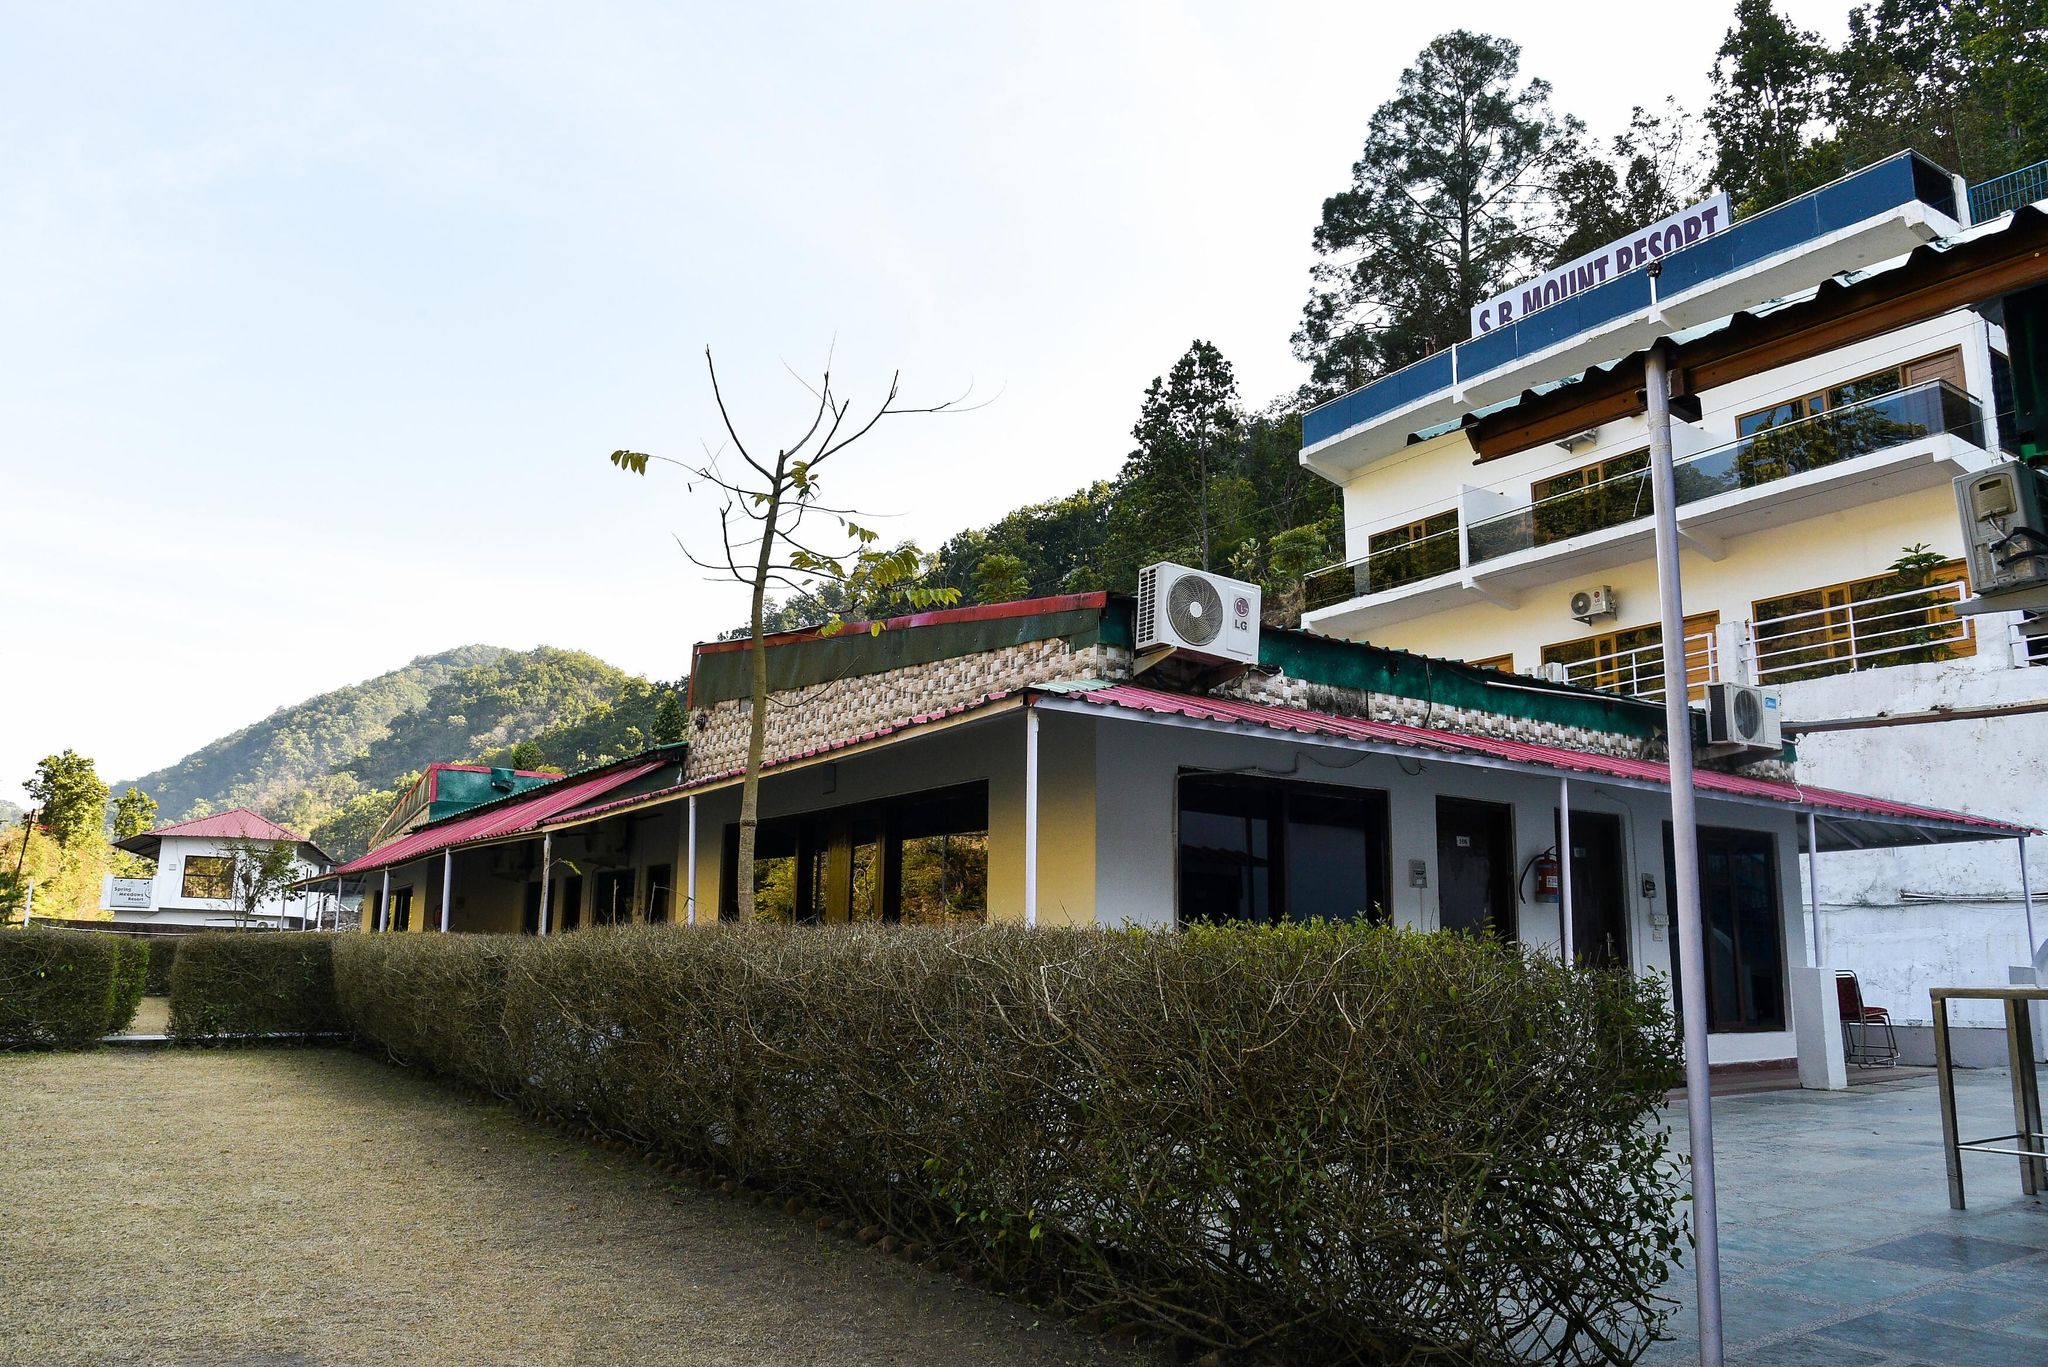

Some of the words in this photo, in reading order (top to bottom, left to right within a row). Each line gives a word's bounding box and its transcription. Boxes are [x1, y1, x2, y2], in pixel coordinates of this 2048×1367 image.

[1522, 254, 1609, 315] MOUNT
[1616, 206, 1718, 274] RESORT
[1235, 619, 1247, 631] LG
